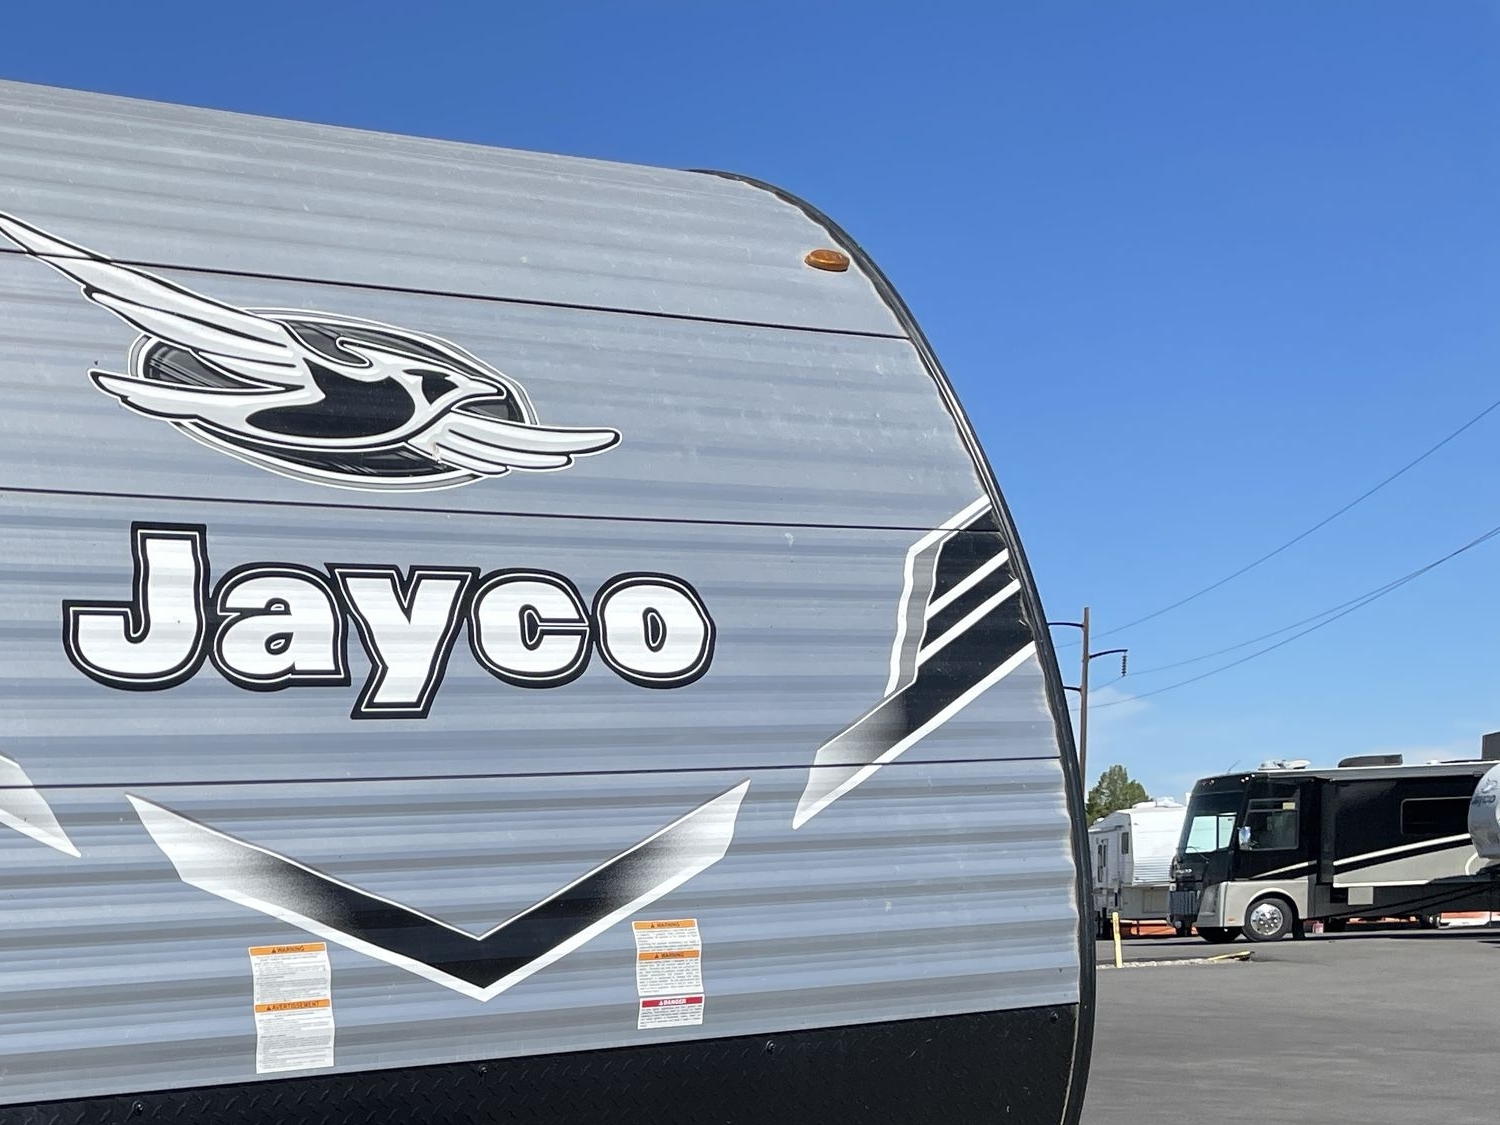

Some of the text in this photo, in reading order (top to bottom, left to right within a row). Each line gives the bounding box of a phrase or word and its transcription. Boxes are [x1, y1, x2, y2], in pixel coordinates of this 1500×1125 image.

[62, 521, 717, 719] Jayco
[277, 945, 305, 953] WARNING
[272, 1001, 320, 1011] AVERTISSEMENT
[663, 998, 687, 1006] DANGER
